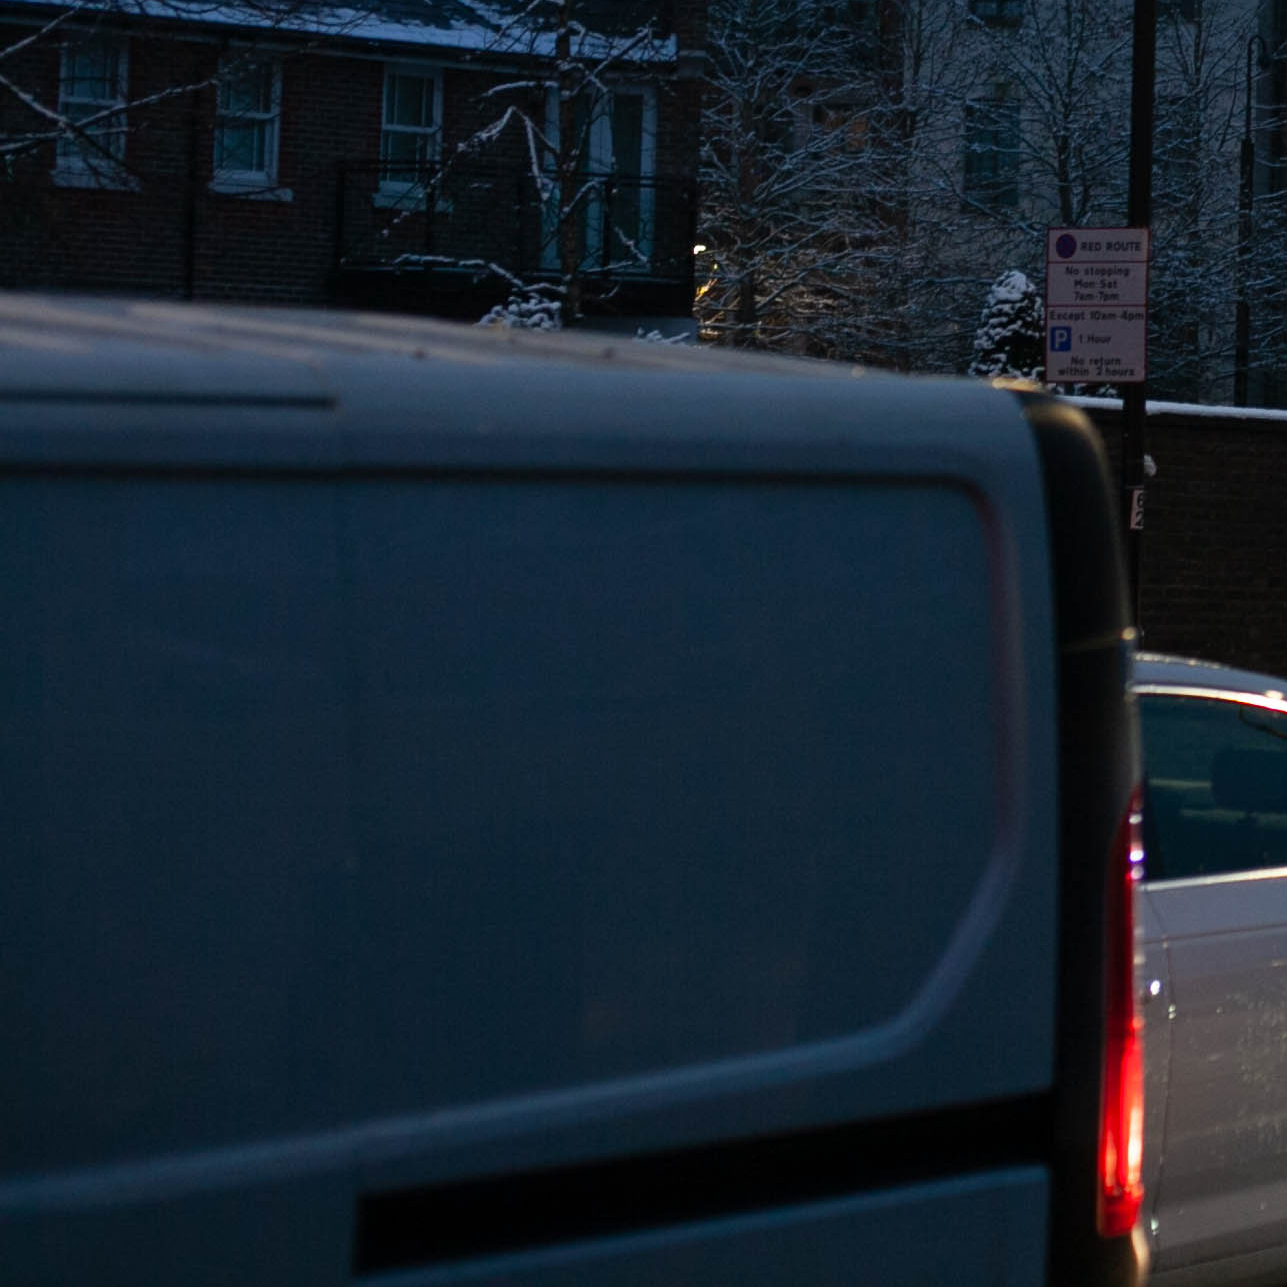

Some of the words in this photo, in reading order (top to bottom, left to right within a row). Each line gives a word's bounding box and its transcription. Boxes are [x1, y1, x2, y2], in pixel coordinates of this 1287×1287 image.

[1081, 241, 1102, 251] RED
[1105, 241, 1141, 251] ROUTE
[1066, 266, 1080, 275] No
[1084, 266, 1130, 278] stopping
[1050, 311, 1085, 321] Except
[1090, 311, 1145, 322] 10am-4pm
[1055, 329, 1068, 349] P
[1087, 334, 1112, 344] Hour
[1071, 356, 1085, 365] No
[1089, 356, 1121, 366] return
[1058, 367, 1090, 376] within
[1096, 367, 1103, 376] 2
[1105, 367, 1135, 376] hours
